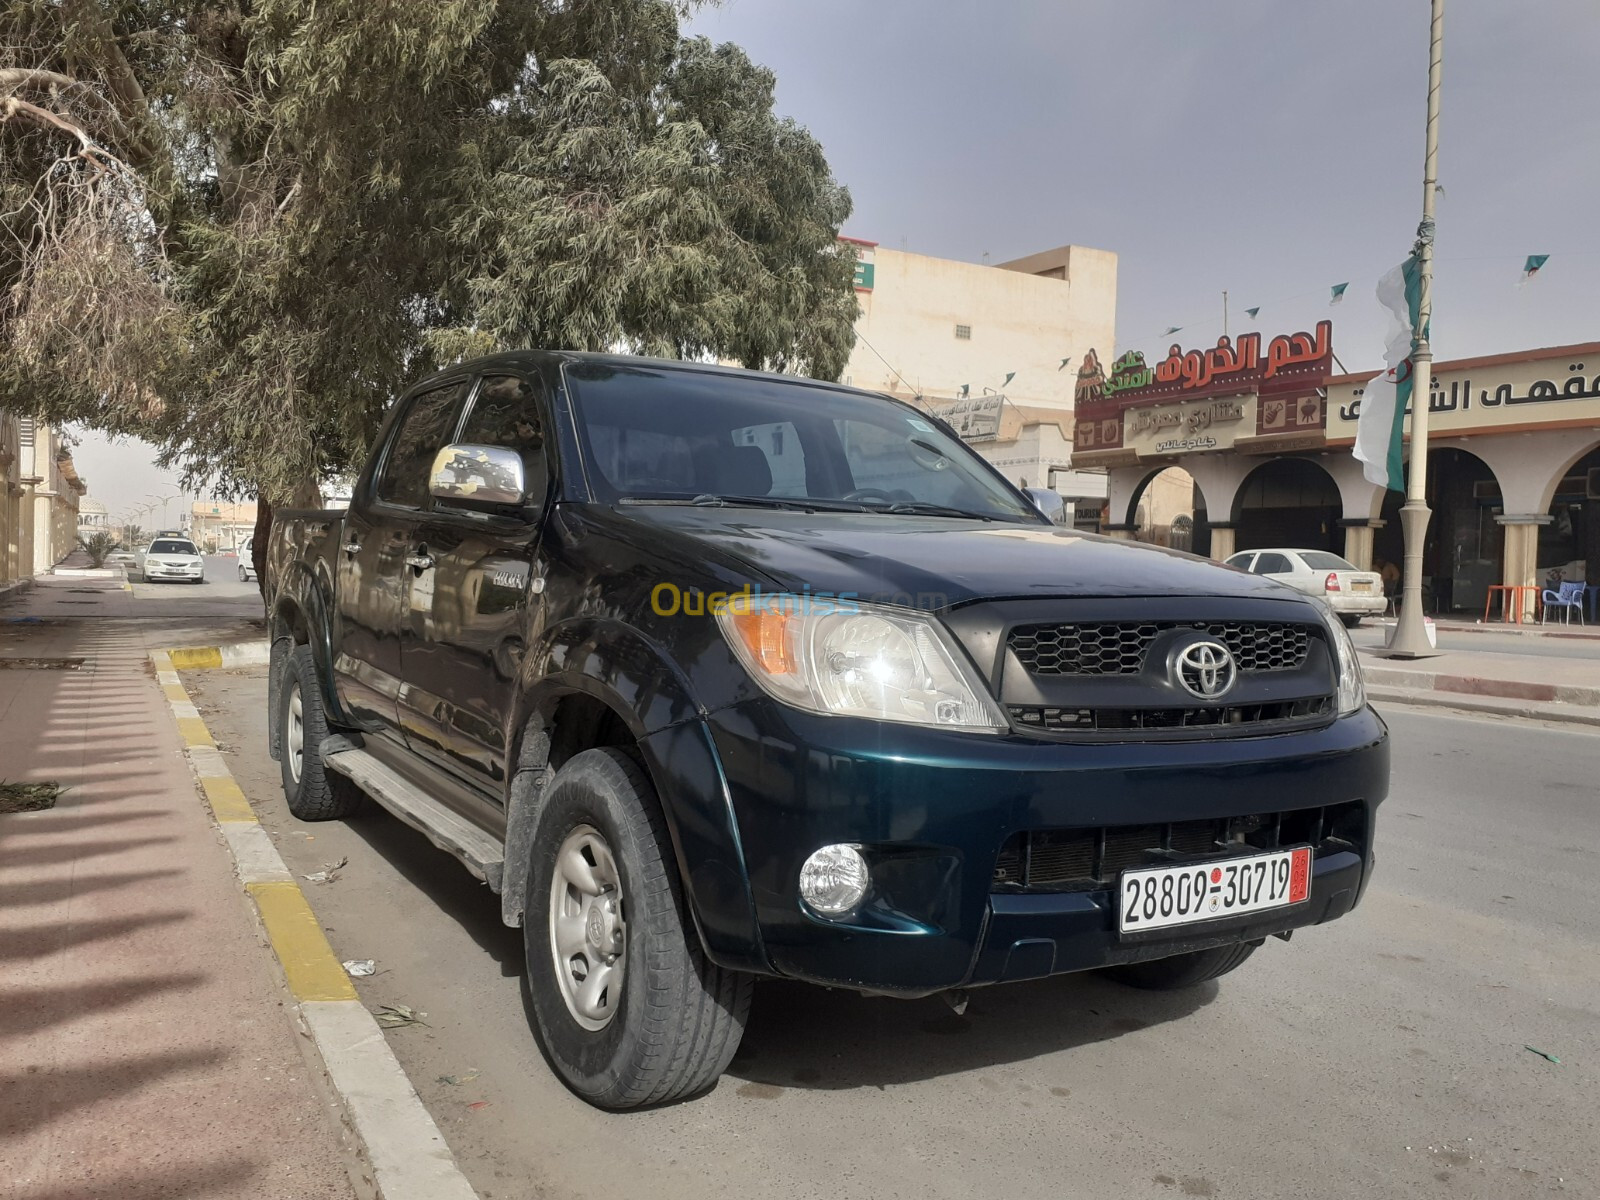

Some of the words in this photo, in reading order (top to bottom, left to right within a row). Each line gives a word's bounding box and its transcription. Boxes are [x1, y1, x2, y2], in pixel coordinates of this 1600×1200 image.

[1156, 337, 1258, 388] الخروف
[1264, 323, 1329, 379] لحم
[1187, 436, 1216, 450] جناح
